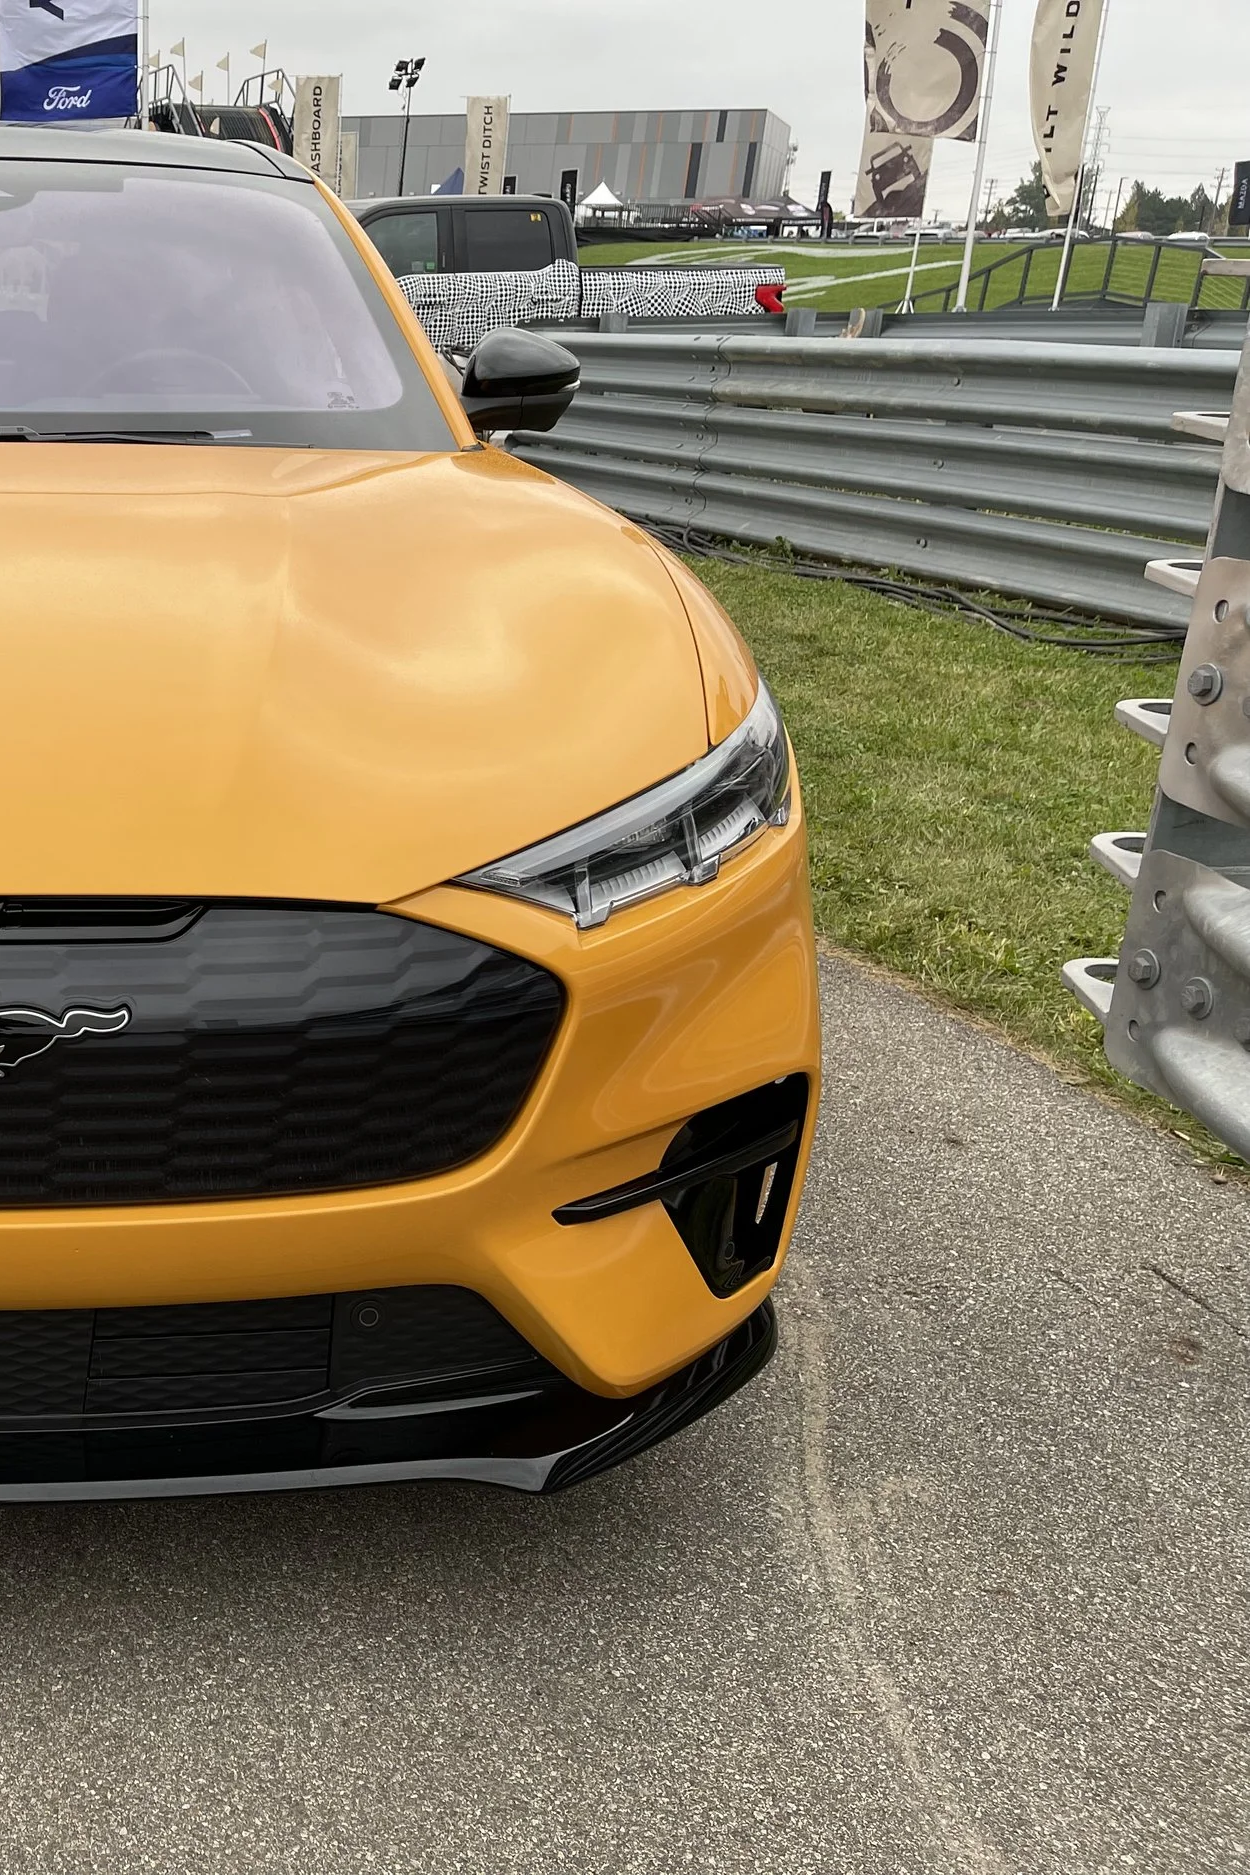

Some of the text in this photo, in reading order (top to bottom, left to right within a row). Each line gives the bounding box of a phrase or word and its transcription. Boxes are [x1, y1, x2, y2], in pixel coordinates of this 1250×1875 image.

[1052, 0, 1080, 86] WILD
[43, 85, 92, 111] Ford
[310, 85, 323, 178] ASHBOARD
[482, 105, 493, 149] DITCH
[1237, 178, 1249, 209] MAZDA
